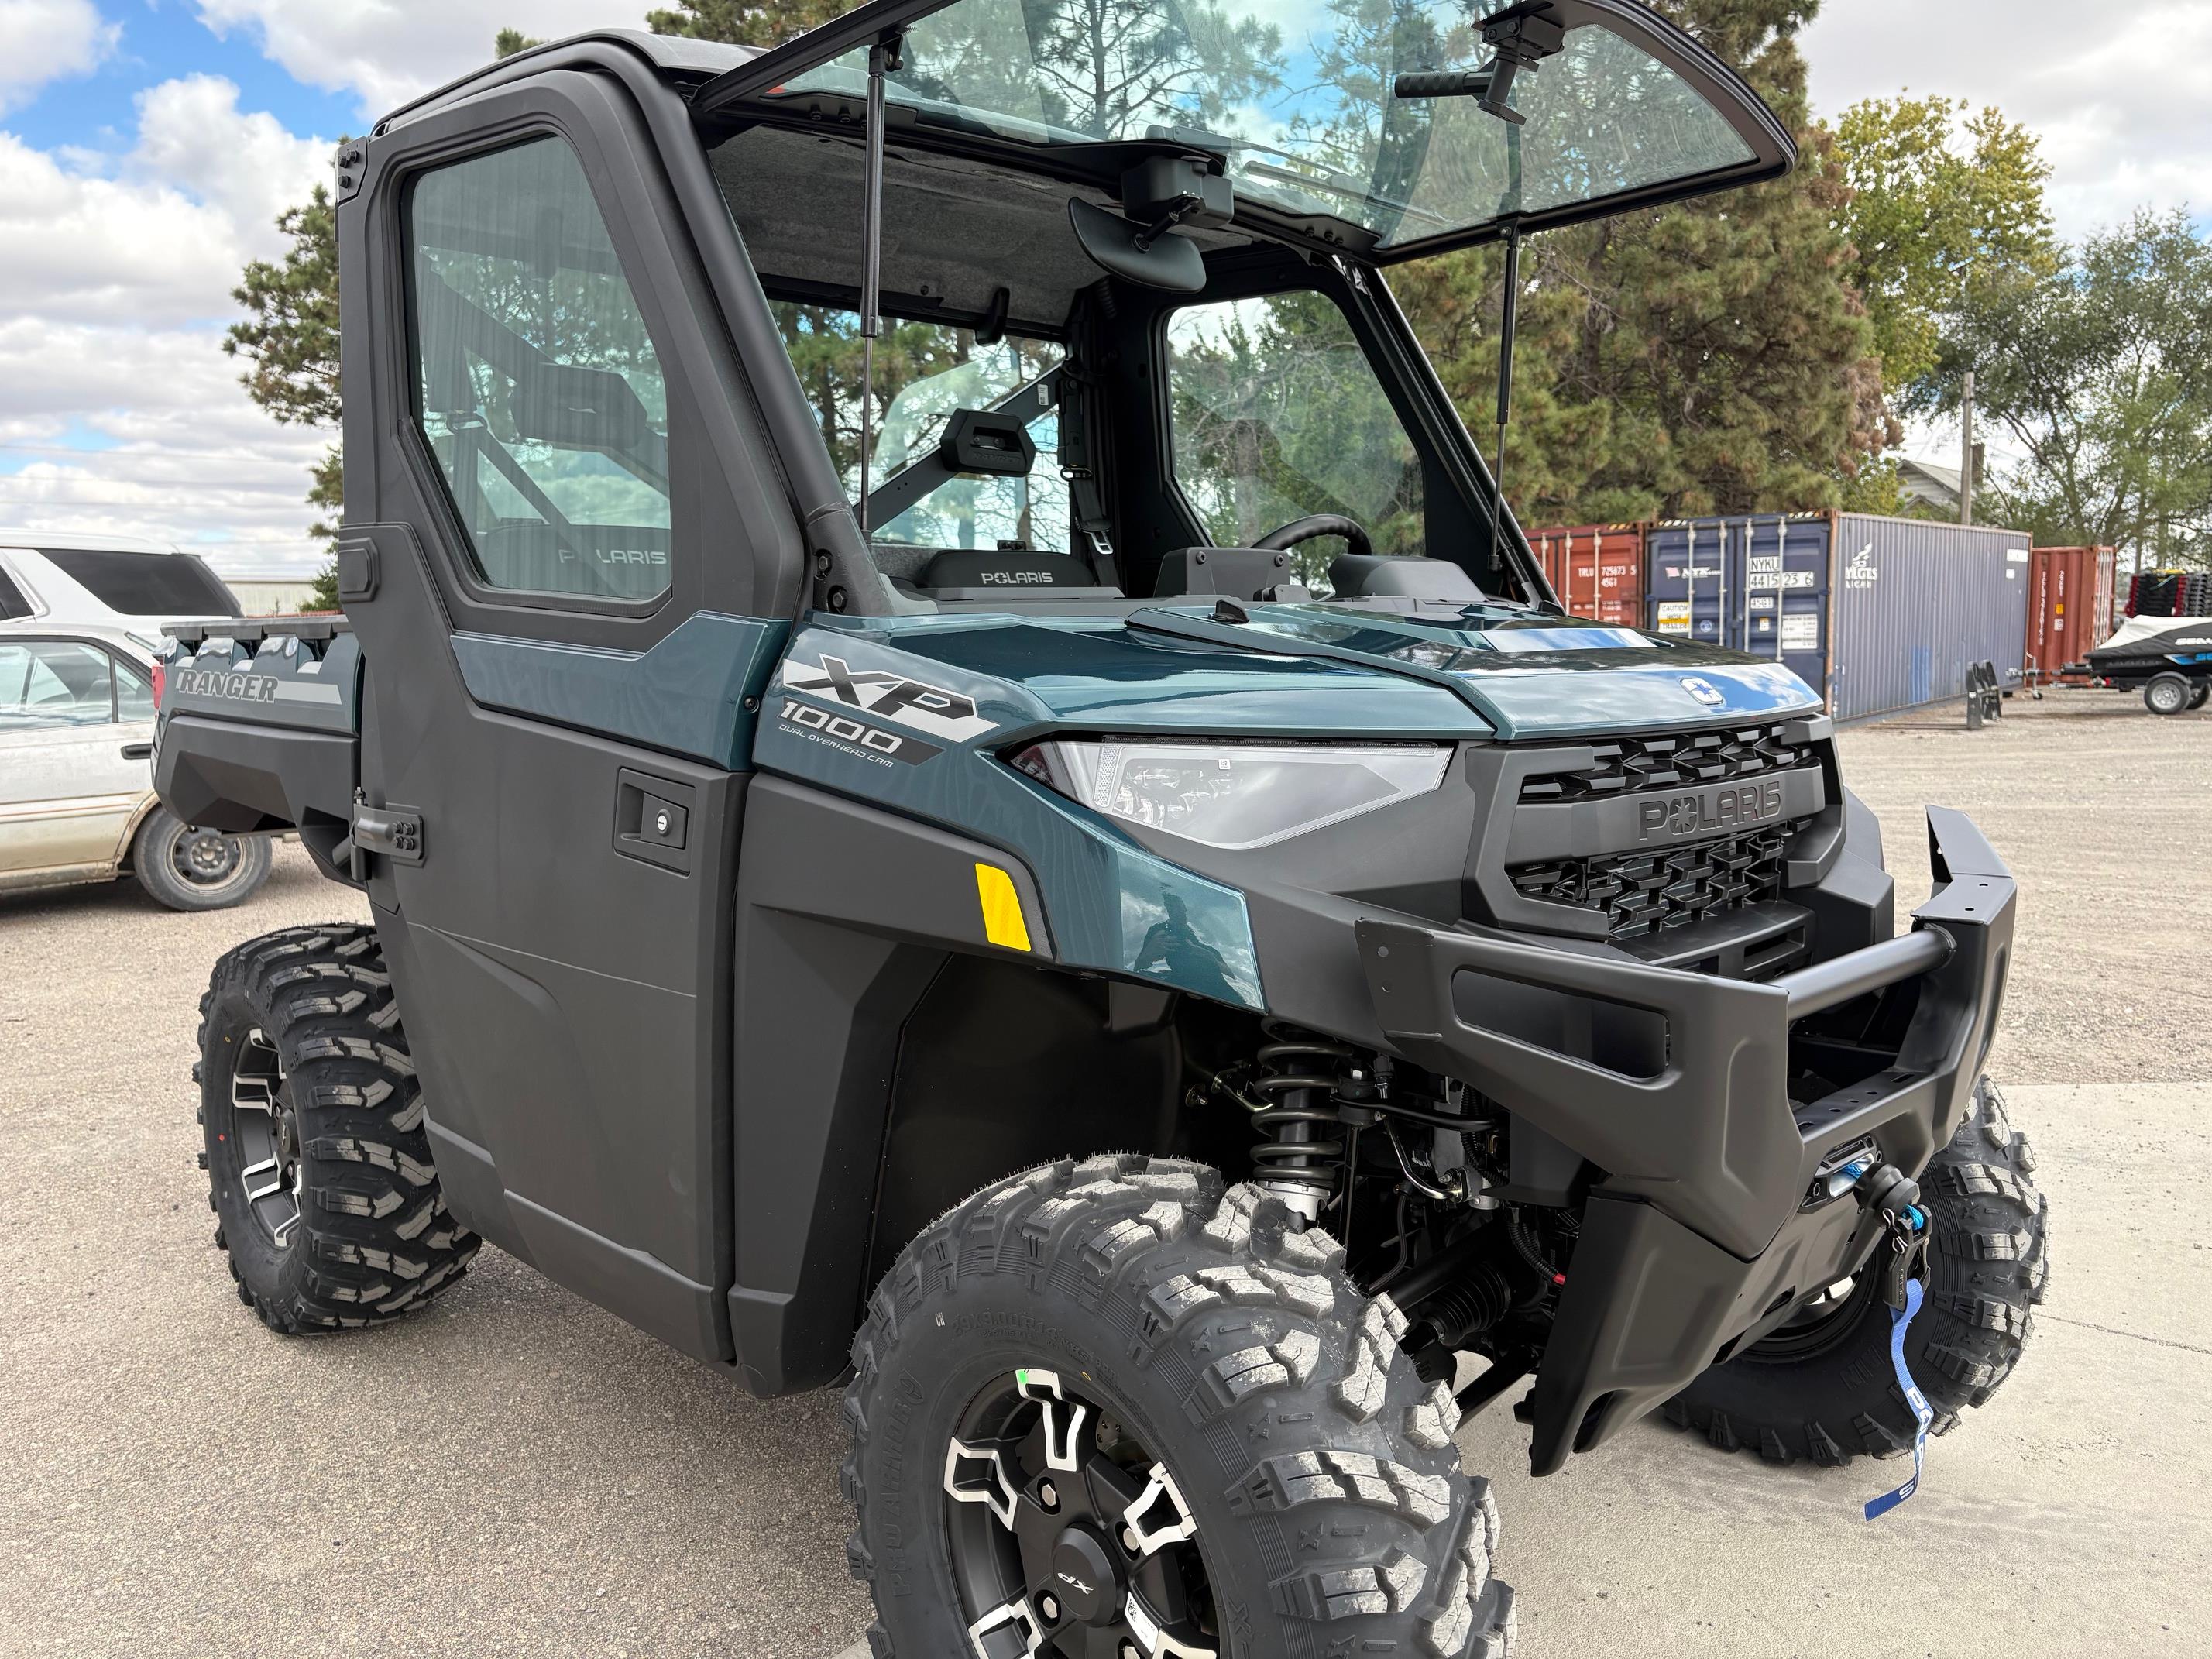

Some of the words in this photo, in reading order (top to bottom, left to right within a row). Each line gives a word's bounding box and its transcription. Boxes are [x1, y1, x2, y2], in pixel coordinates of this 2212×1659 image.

[558, 548, 667, 565] PLARIS
[1751, 558, 1779, 571] NYKU
[981, 572, 1053, 585] POLARIS
[179, 669, 279, 704] RANGER
[786, 653, 977, 721] XP
[780, 701, 903, 754] 1000
[778, 723, 806, 737] DUAL
[808, 734, 867, 758] OVERHEAD
[867, 754, 895, 768] CAM
[1639, 781, 1781, 840] POLARIS
[1057, 1572, 1094, 1595] XP
